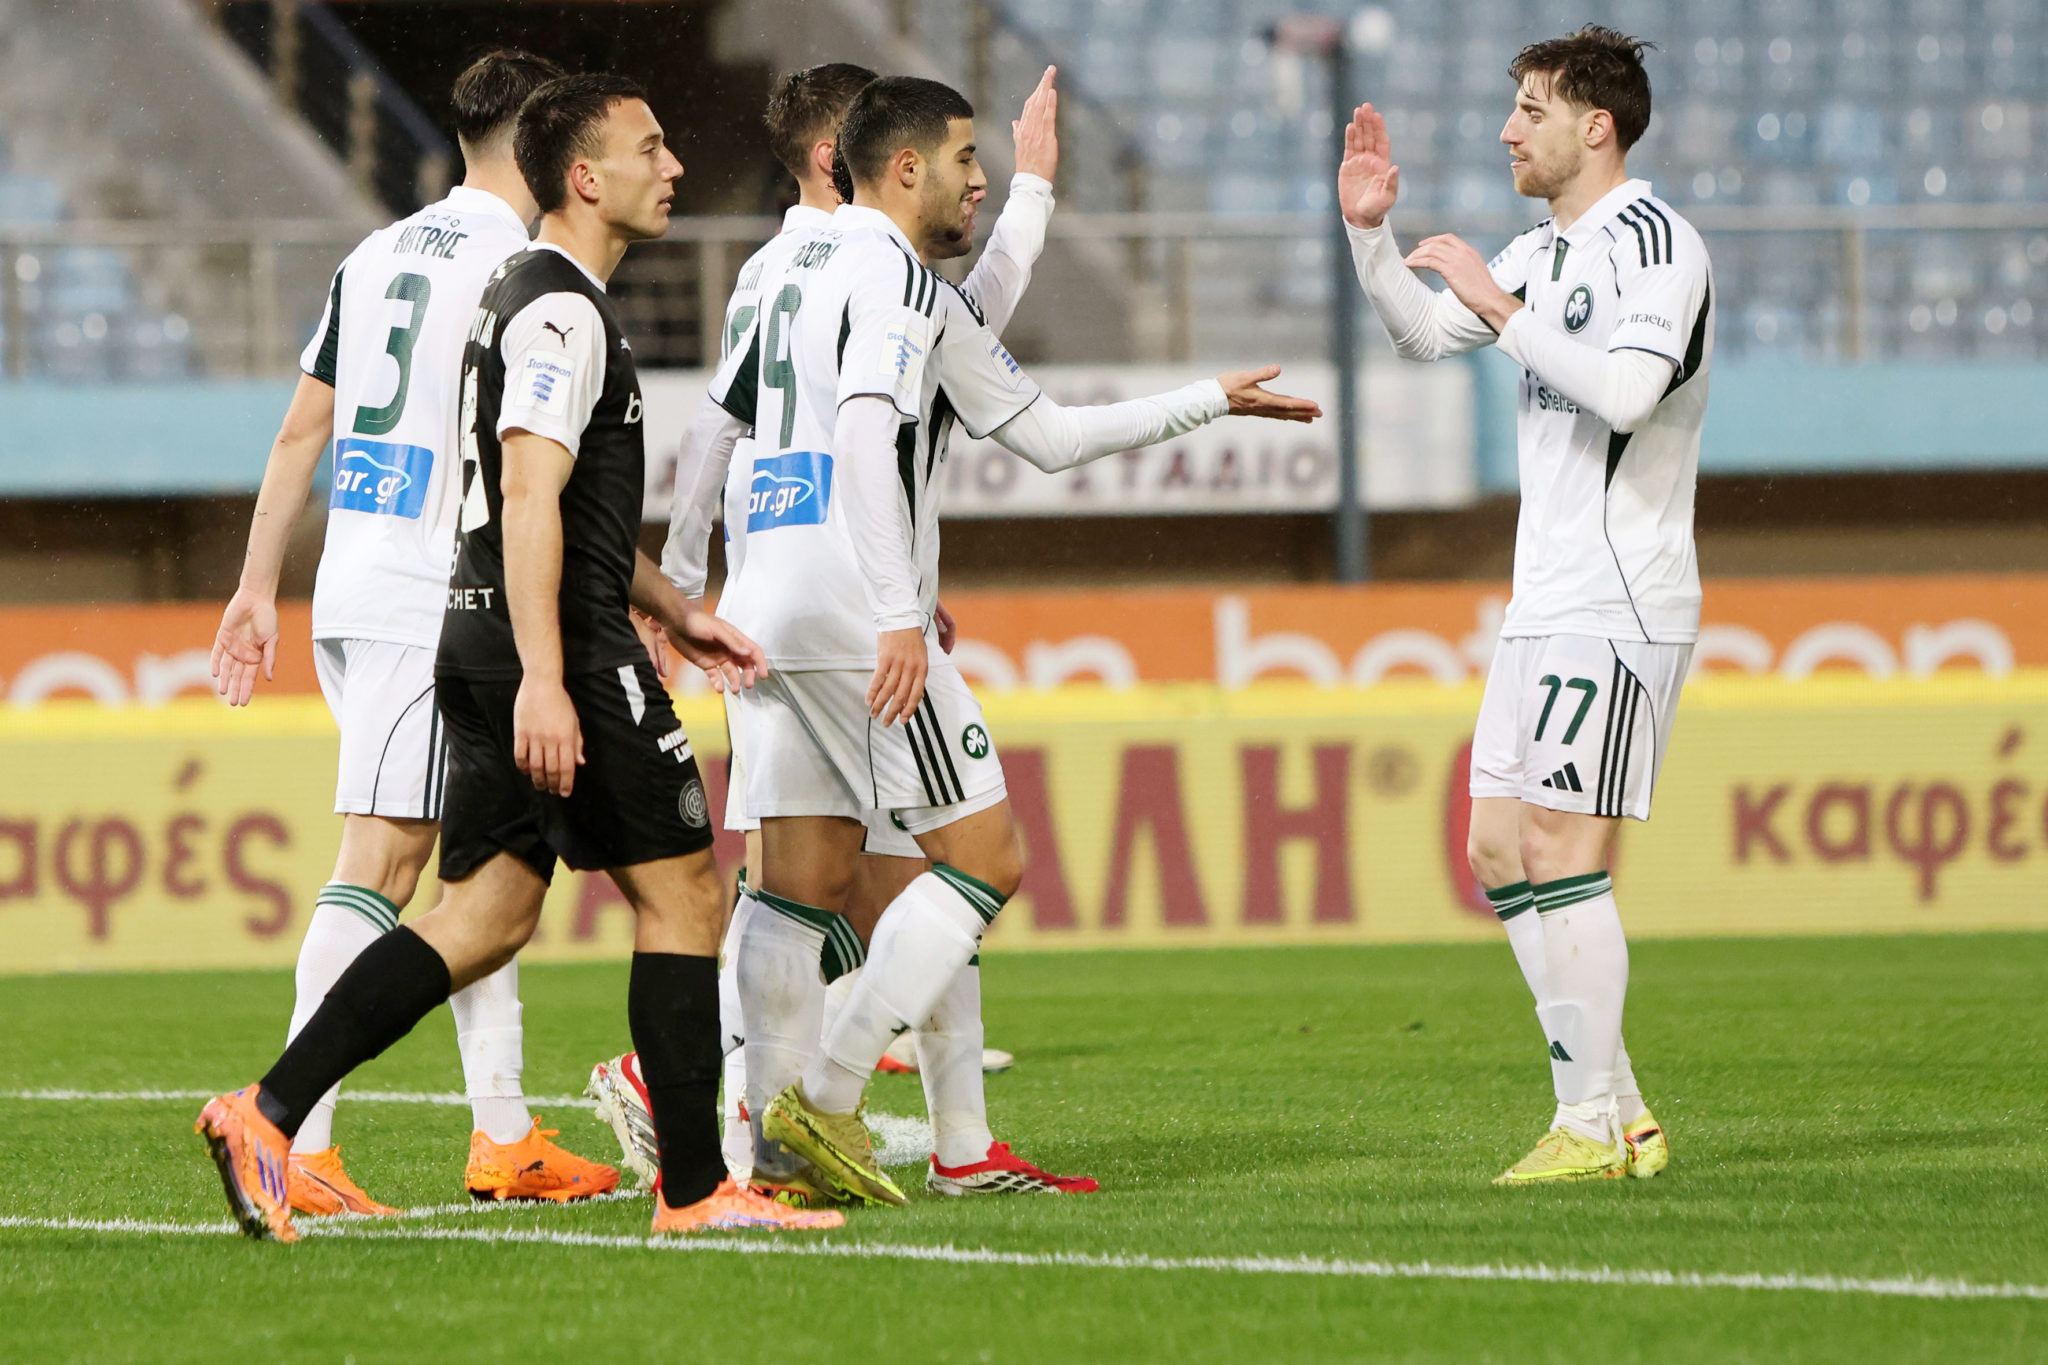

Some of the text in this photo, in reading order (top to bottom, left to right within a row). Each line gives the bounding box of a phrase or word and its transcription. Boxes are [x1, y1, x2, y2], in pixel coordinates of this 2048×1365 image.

[352, 272, 431, 435] 3
[1068, 446, 1324, 493] ΤΑΔΙΟ
[1535, 674, 1598, 745] 77
[1732, 722, 2048, 905] καφέ
